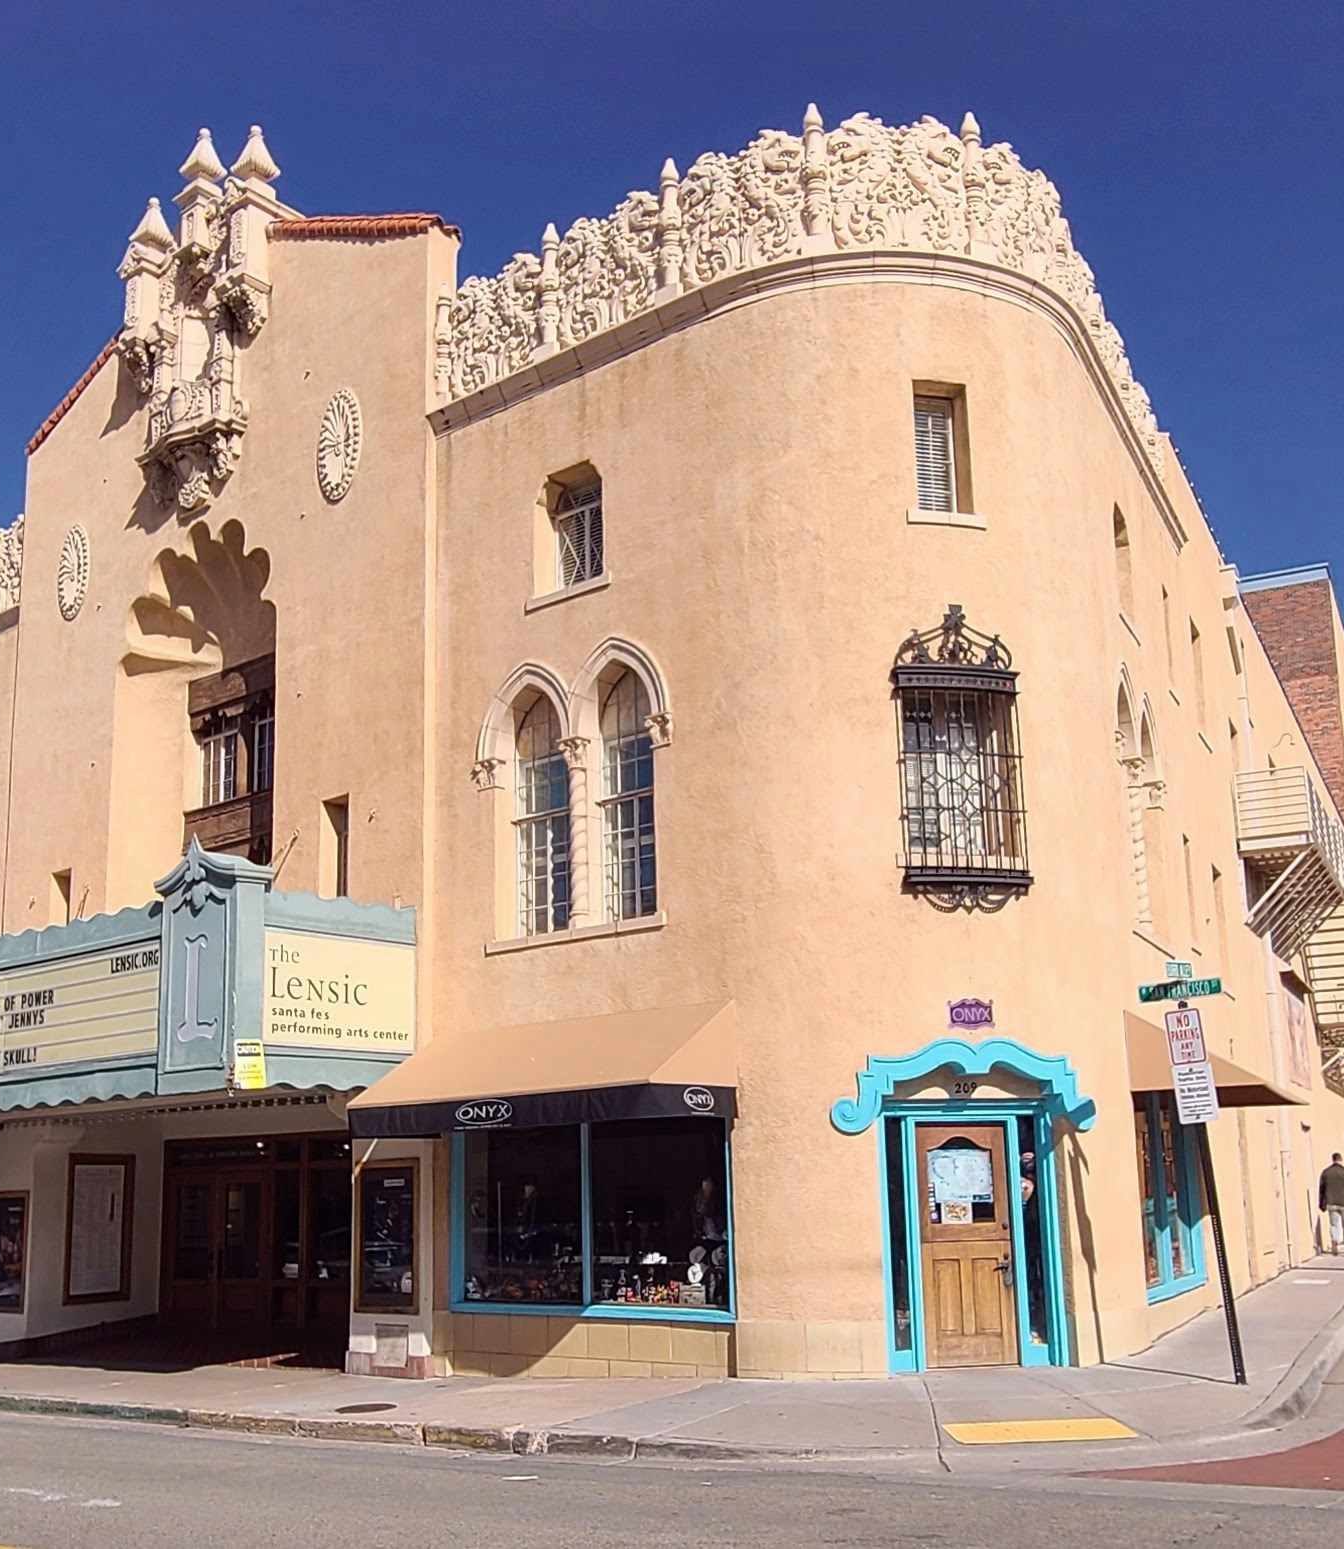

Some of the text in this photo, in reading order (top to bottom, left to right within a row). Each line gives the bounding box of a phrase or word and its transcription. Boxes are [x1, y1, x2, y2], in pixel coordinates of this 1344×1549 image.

[110, 949, 159, 974] LENSIC.ORG
[1167, 982, 1210, 998] FRANCISCO
[4, 995, 16, 1012] OF
[21, 989, 55, 1008] POWER
[8, 1009, 46, 1029] JENNYS
[271, 1007, 306, 1018] santa
[952, 1007, 991, 1022] ONYX
[1176, 1013, 1190, 1028] NO
[271, 1021, 409, 1041] performing arts center
[1170, 1028, 1200, 1042] PARKING
[1180, 1043, 1194, 1051] ANY
[1181, 1050, 1196, 1059] TIME
[3, 1047, 37, 1067] SKULL!
[954, 1081, 978, 1094] 209
[458, 1105, 508, 1120] ONYX
